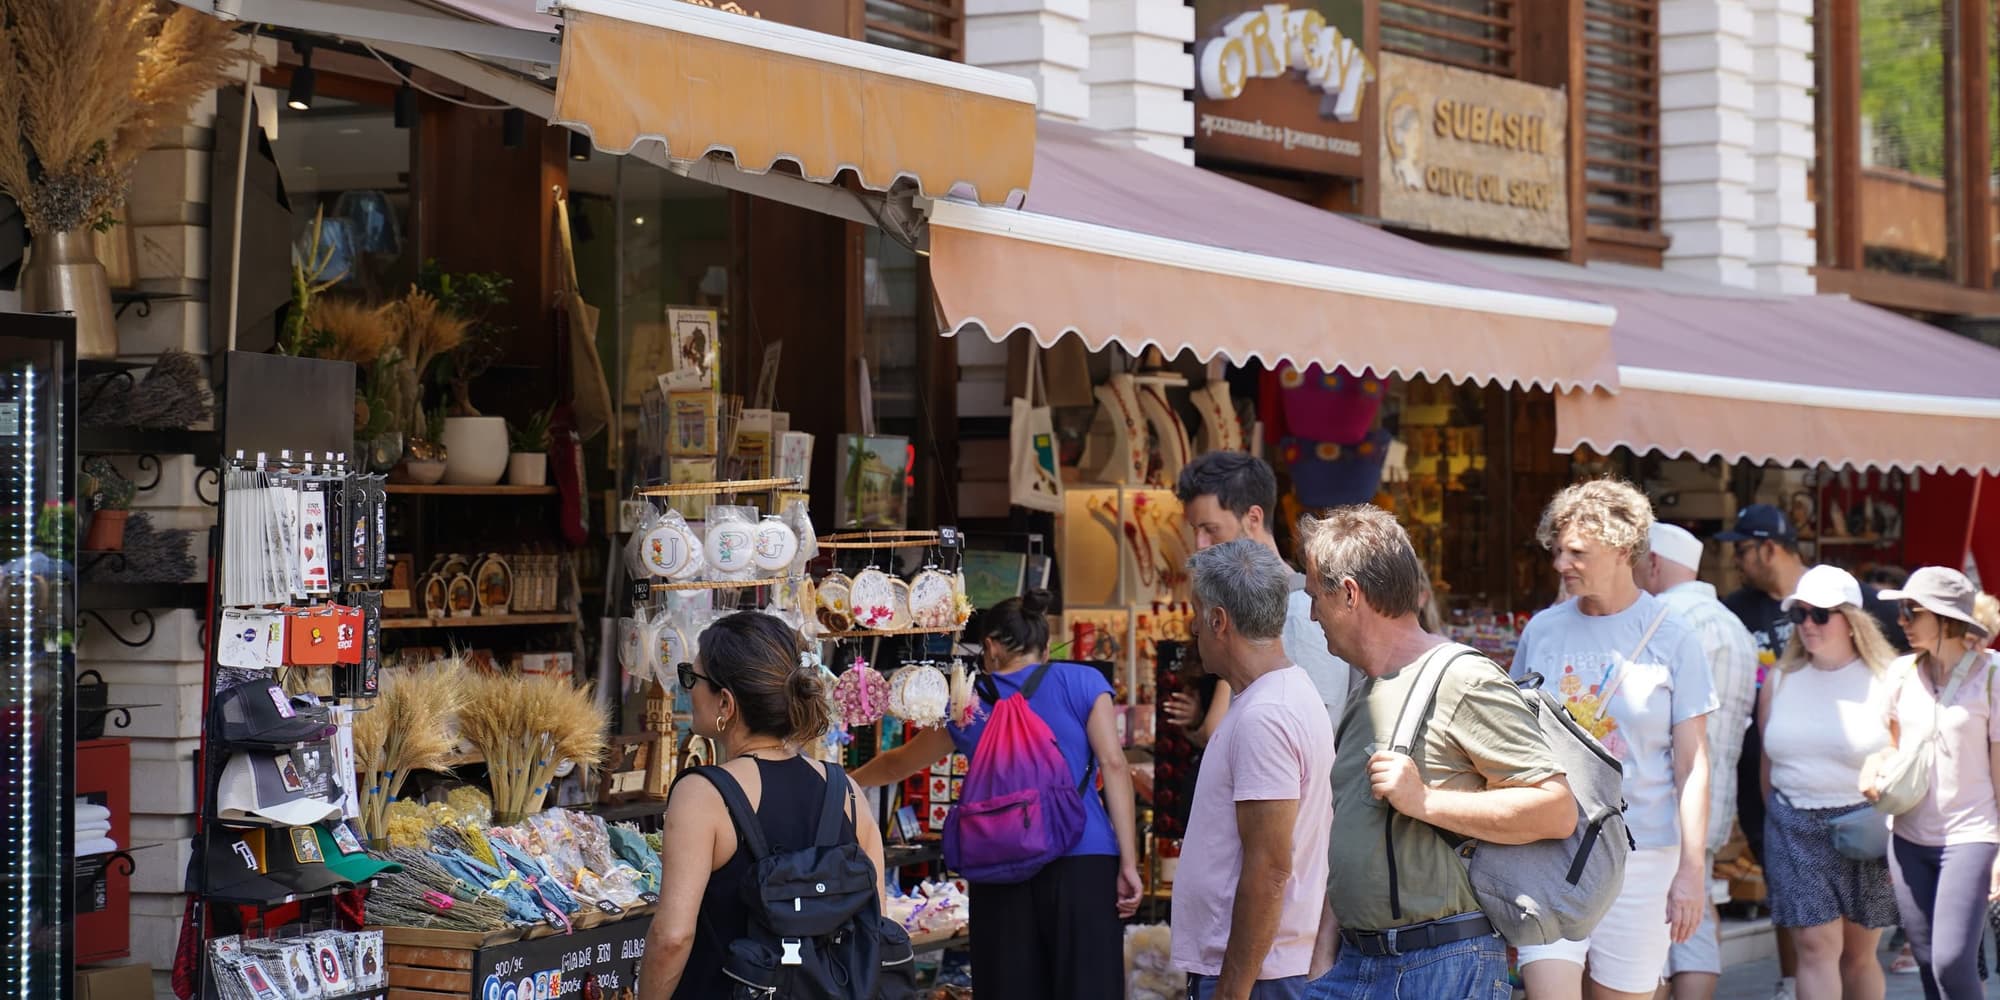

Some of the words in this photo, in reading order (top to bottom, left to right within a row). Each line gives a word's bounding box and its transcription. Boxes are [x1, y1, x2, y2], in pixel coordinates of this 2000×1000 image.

[1434, 98, 1549, 154] SUBASHI
[1426, 165, 1473, 201] OLIVE
[1478, 174, 1505, 205] OIL
[1508, 178, 1552, 212] SHOP
[561, 947, 592, 974] MADE
[597, 943, 611, 964] IN
